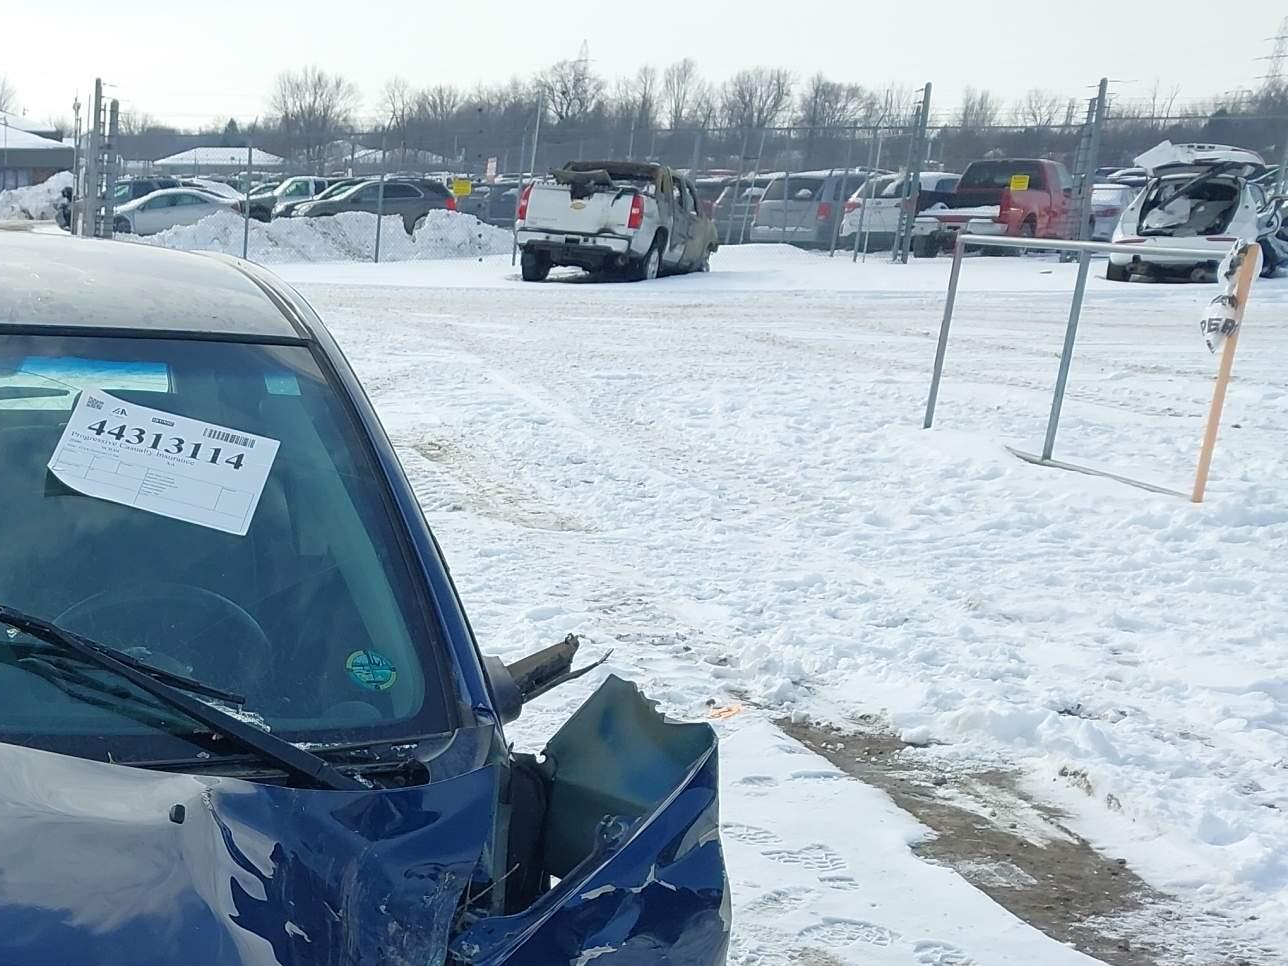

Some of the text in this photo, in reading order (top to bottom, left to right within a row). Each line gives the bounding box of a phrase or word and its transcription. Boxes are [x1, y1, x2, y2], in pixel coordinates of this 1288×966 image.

[71, 431, 119, 448] Progressive
[156, 450, 195, 466] Insurance
[87, 419, 245, 470] 44313114
